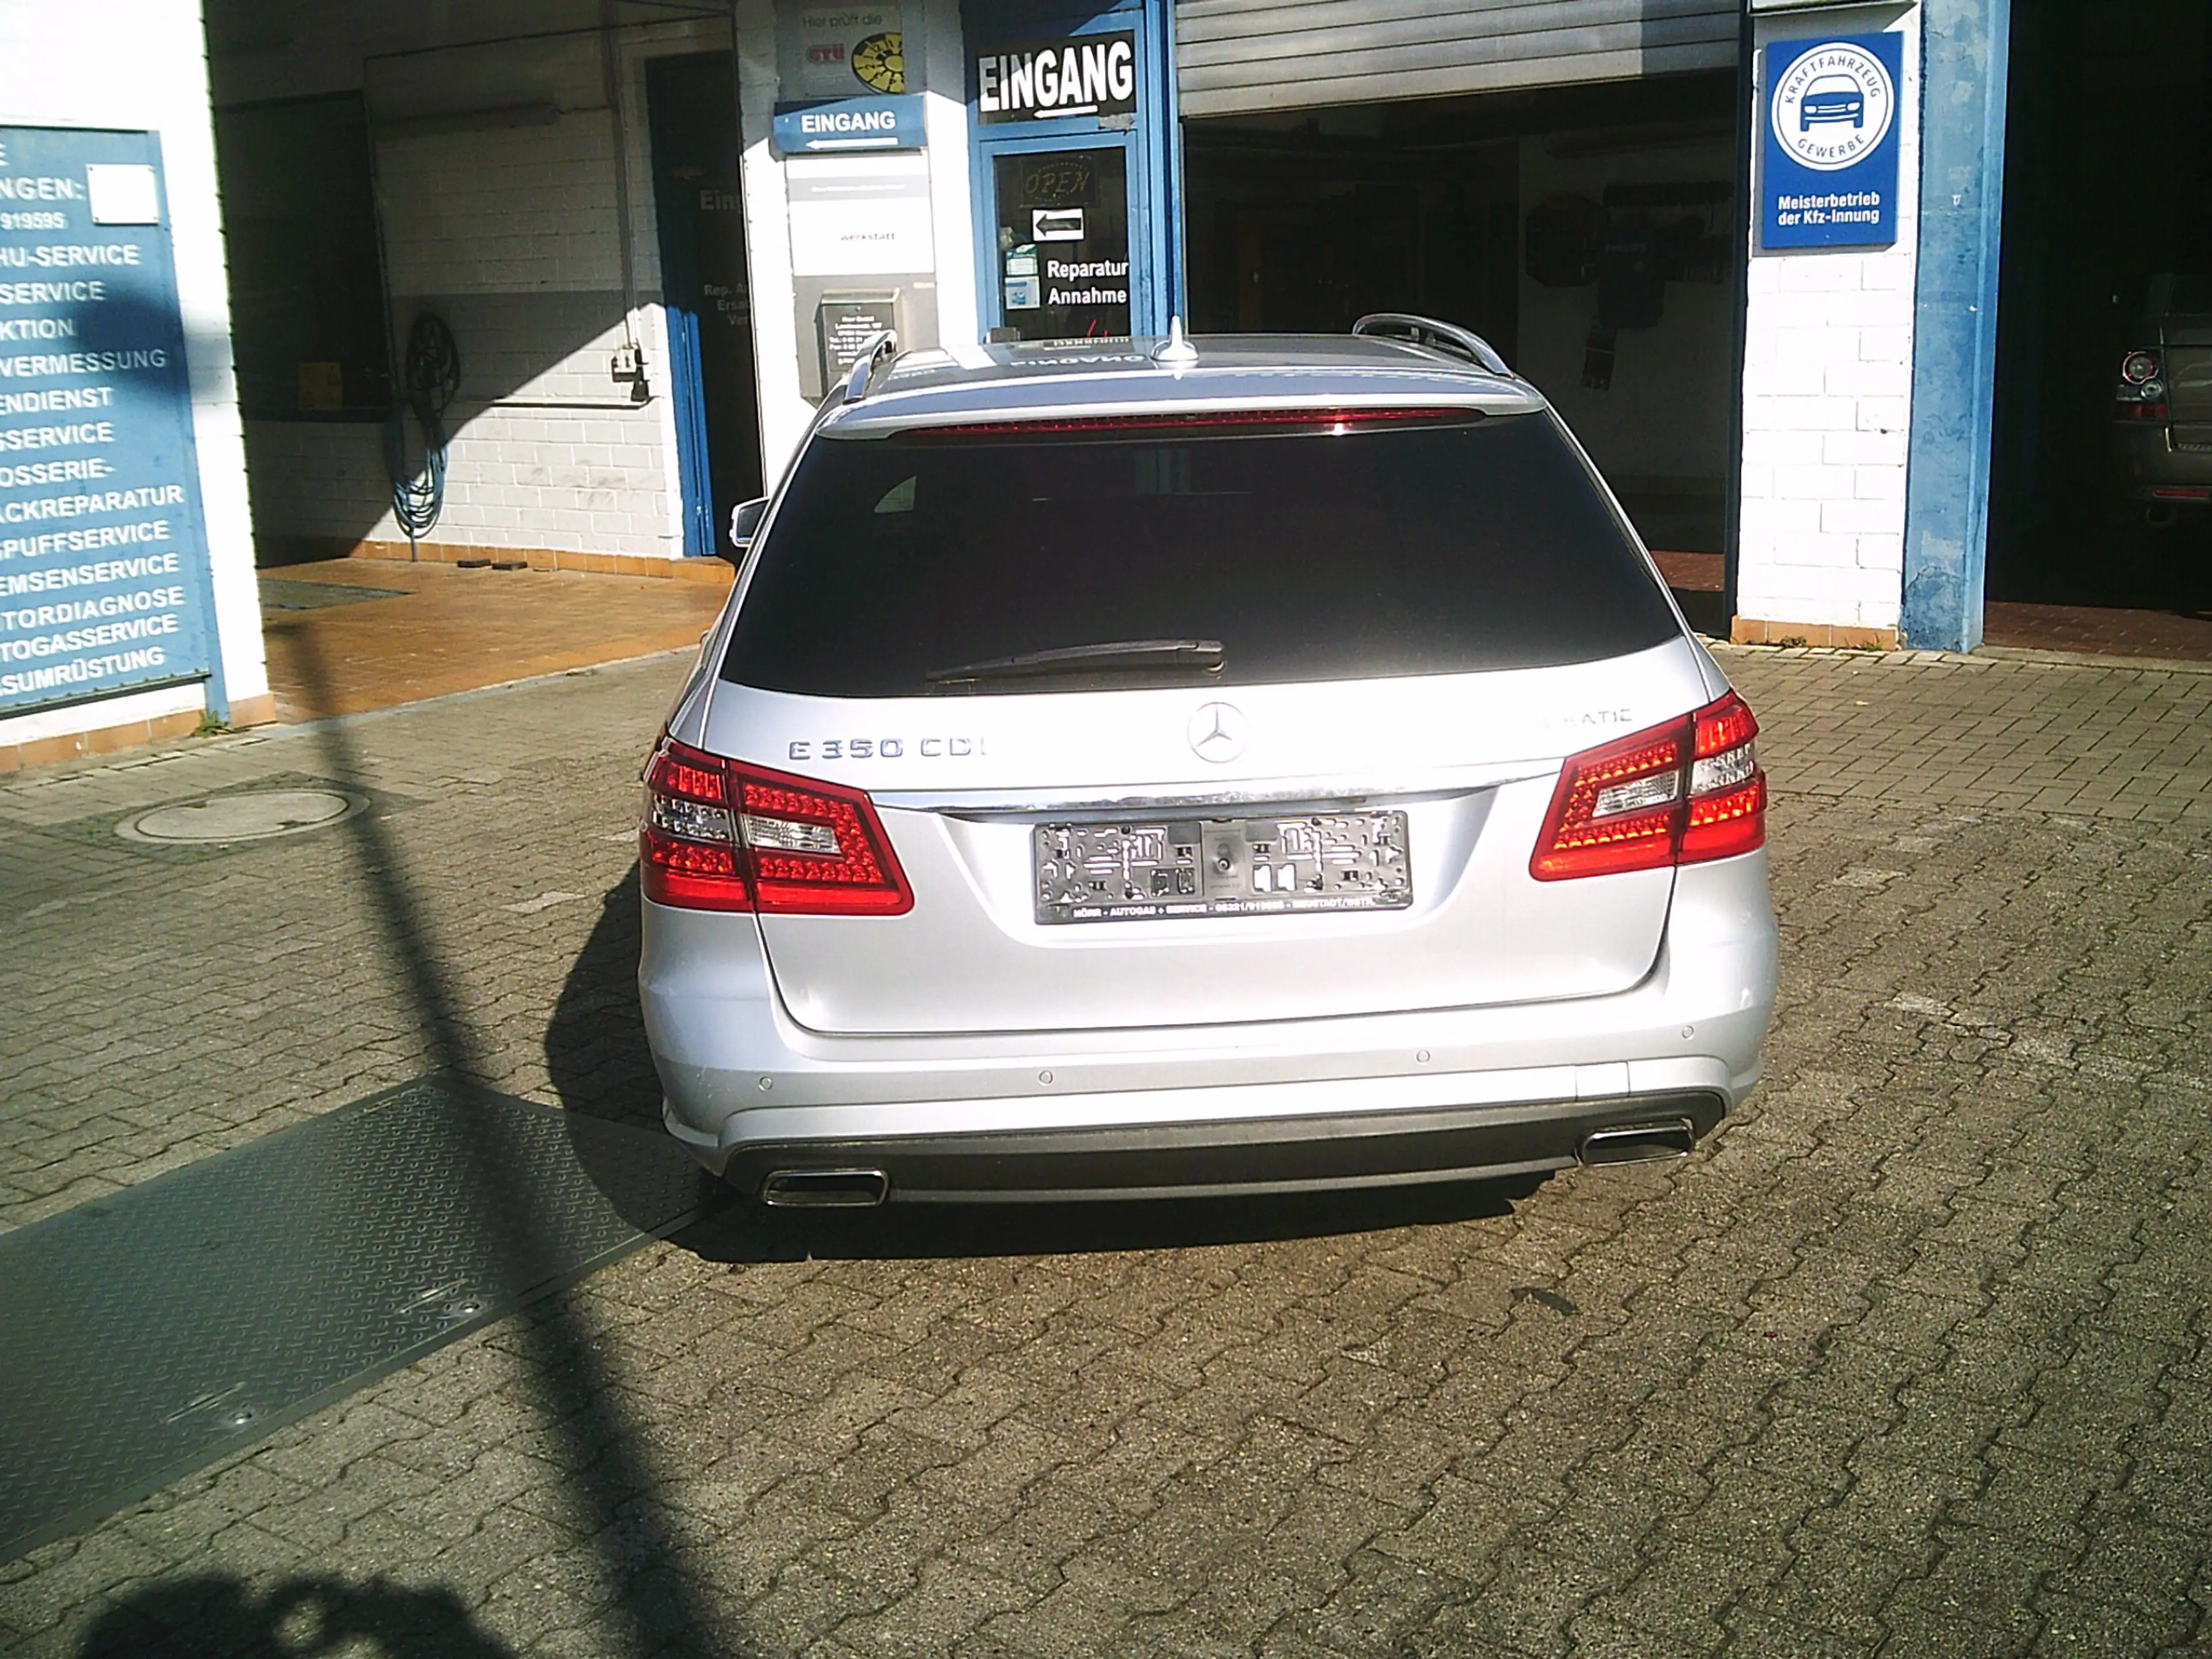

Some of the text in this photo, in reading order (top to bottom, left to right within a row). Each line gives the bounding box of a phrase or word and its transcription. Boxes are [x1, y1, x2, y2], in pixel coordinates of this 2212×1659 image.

[979, 40, 1132, 112] EINGANG
[1785, 55, 1881, 104] KRAFTFAHRZEUG
[802, 111, 896, 132] EINGANG
[1798, 133, 1864, 157] GEWERBE
[1025, 171, 1090, 194] OPEN
[1778, 192, 1880, 210] Meisterbetrieb
[1778, 209, 1879, 225] der Kfz-Innung
[1047, 260, 1128, 282] Reparatur
[1048, 287, 1127, 305] Annahme
[0, 318, 77, 339] KTION
[0, 520, 172, 562] PUFFSERVICE
[0, 646, 165, 696] SUMRÜSTUNG
